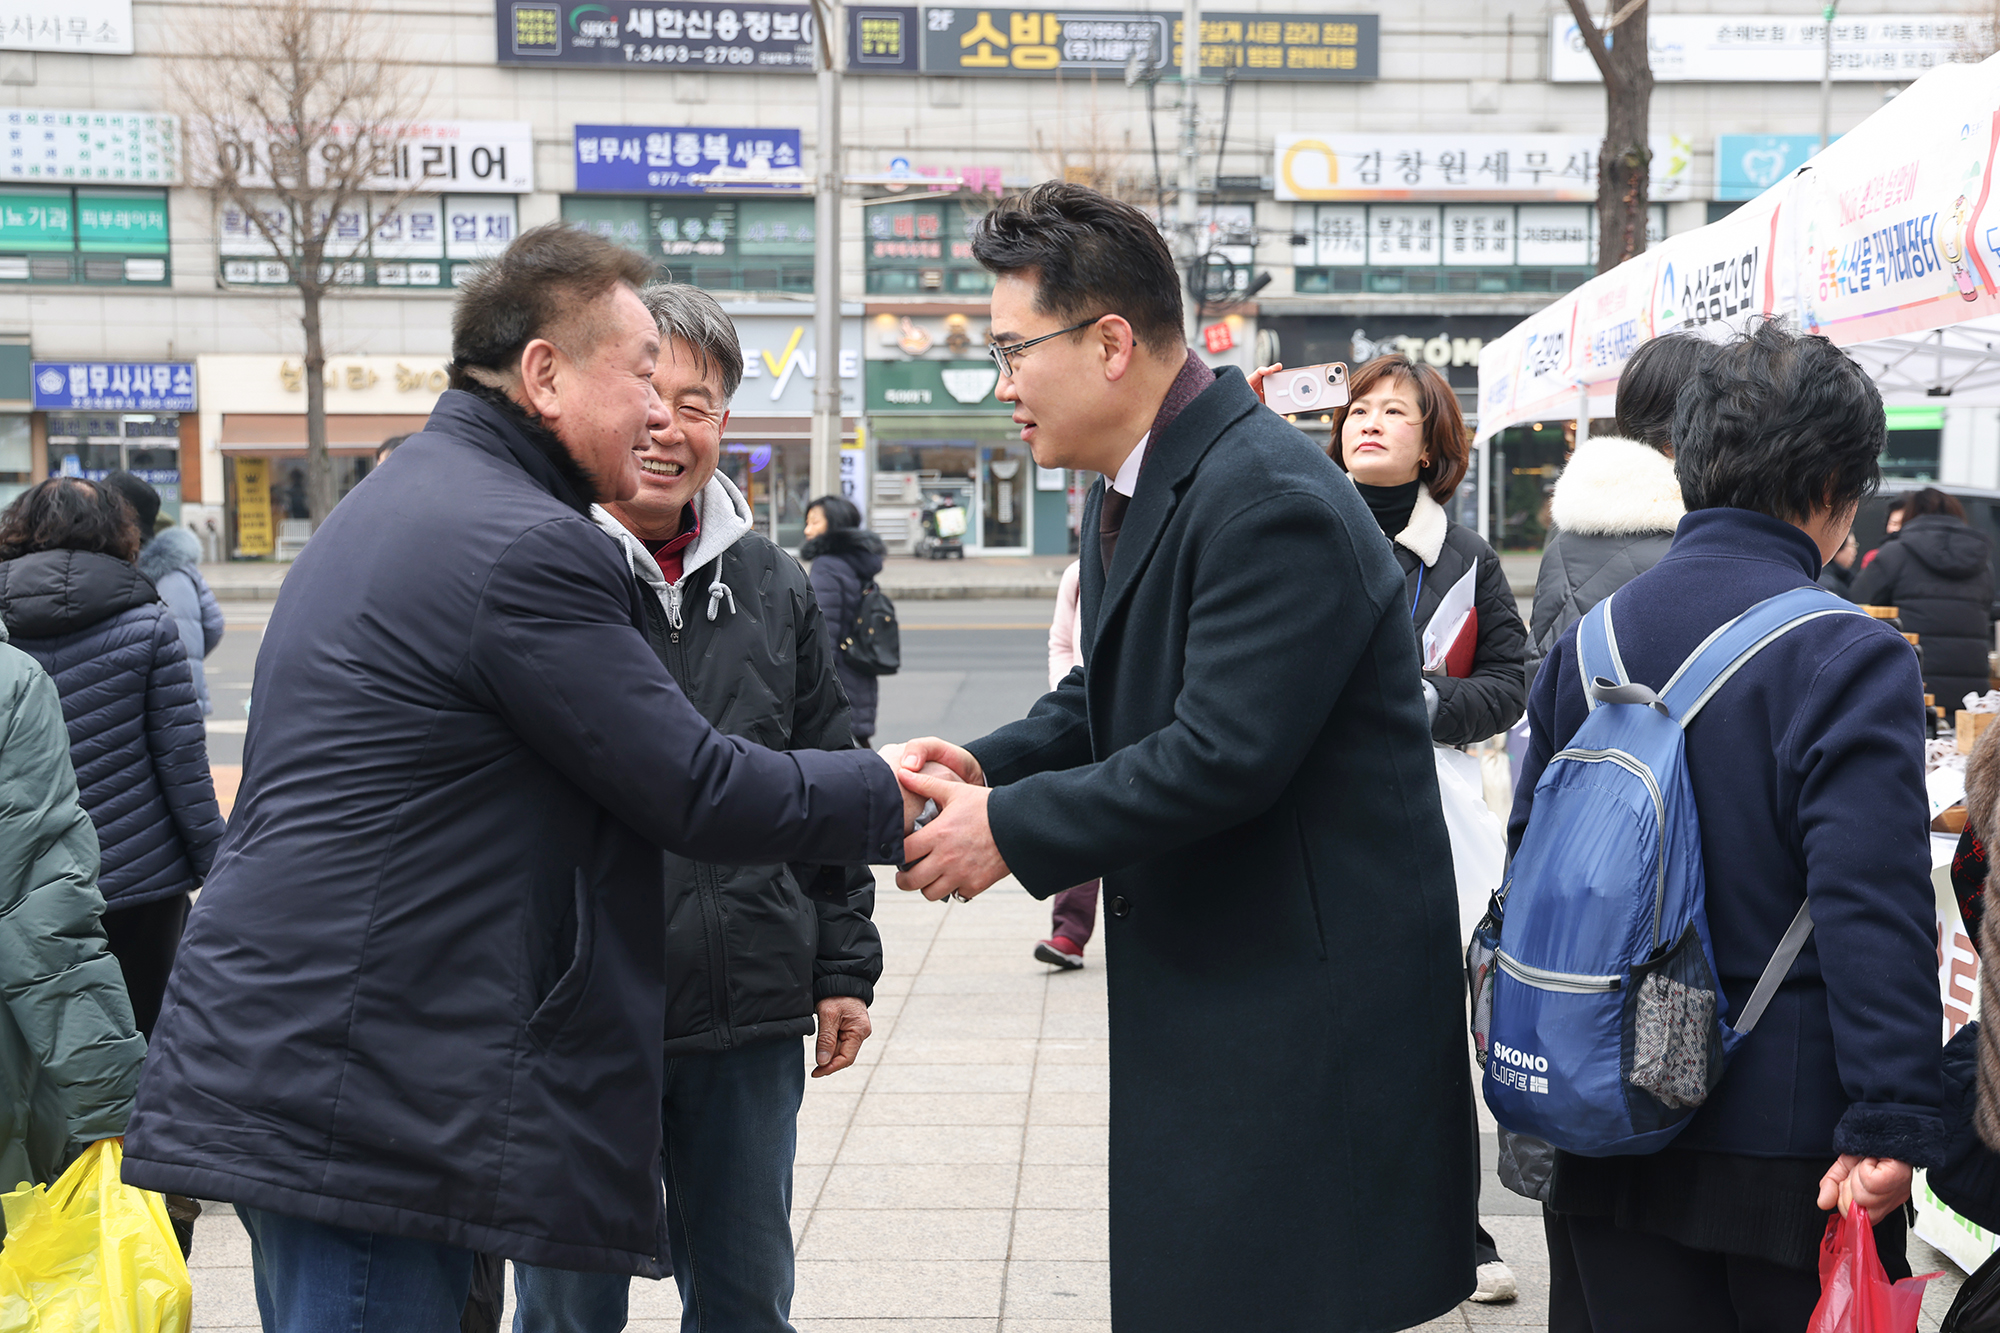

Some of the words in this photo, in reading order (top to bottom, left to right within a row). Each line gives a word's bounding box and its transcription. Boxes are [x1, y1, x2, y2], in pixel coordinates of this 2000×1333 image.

[927, 9, 954, 32] 2F
[1716, 23, 1786, 42] 손해보험
[623, 44, 754, 64] T.3493-2700
[960, 11, 1062, 70] 소방
[578, 136, 642, 165] 법무사
[733, 140, 797, 165] 사무소
[1884, 160, 1920, 209] 설맞이
[82, 209, 164, 230] 피부레이저
[452, 214, 510, 242] 업체
[1818, 237, 1871, 302] 농축수산물
[1873, 212, 1942, 287] 직거래장터
[69, 365, 191, 397] 법무사사무소
[1493, 1041, 1549, 1073] SKONO
[1491, 1061, 1528, 1092] LIFE
